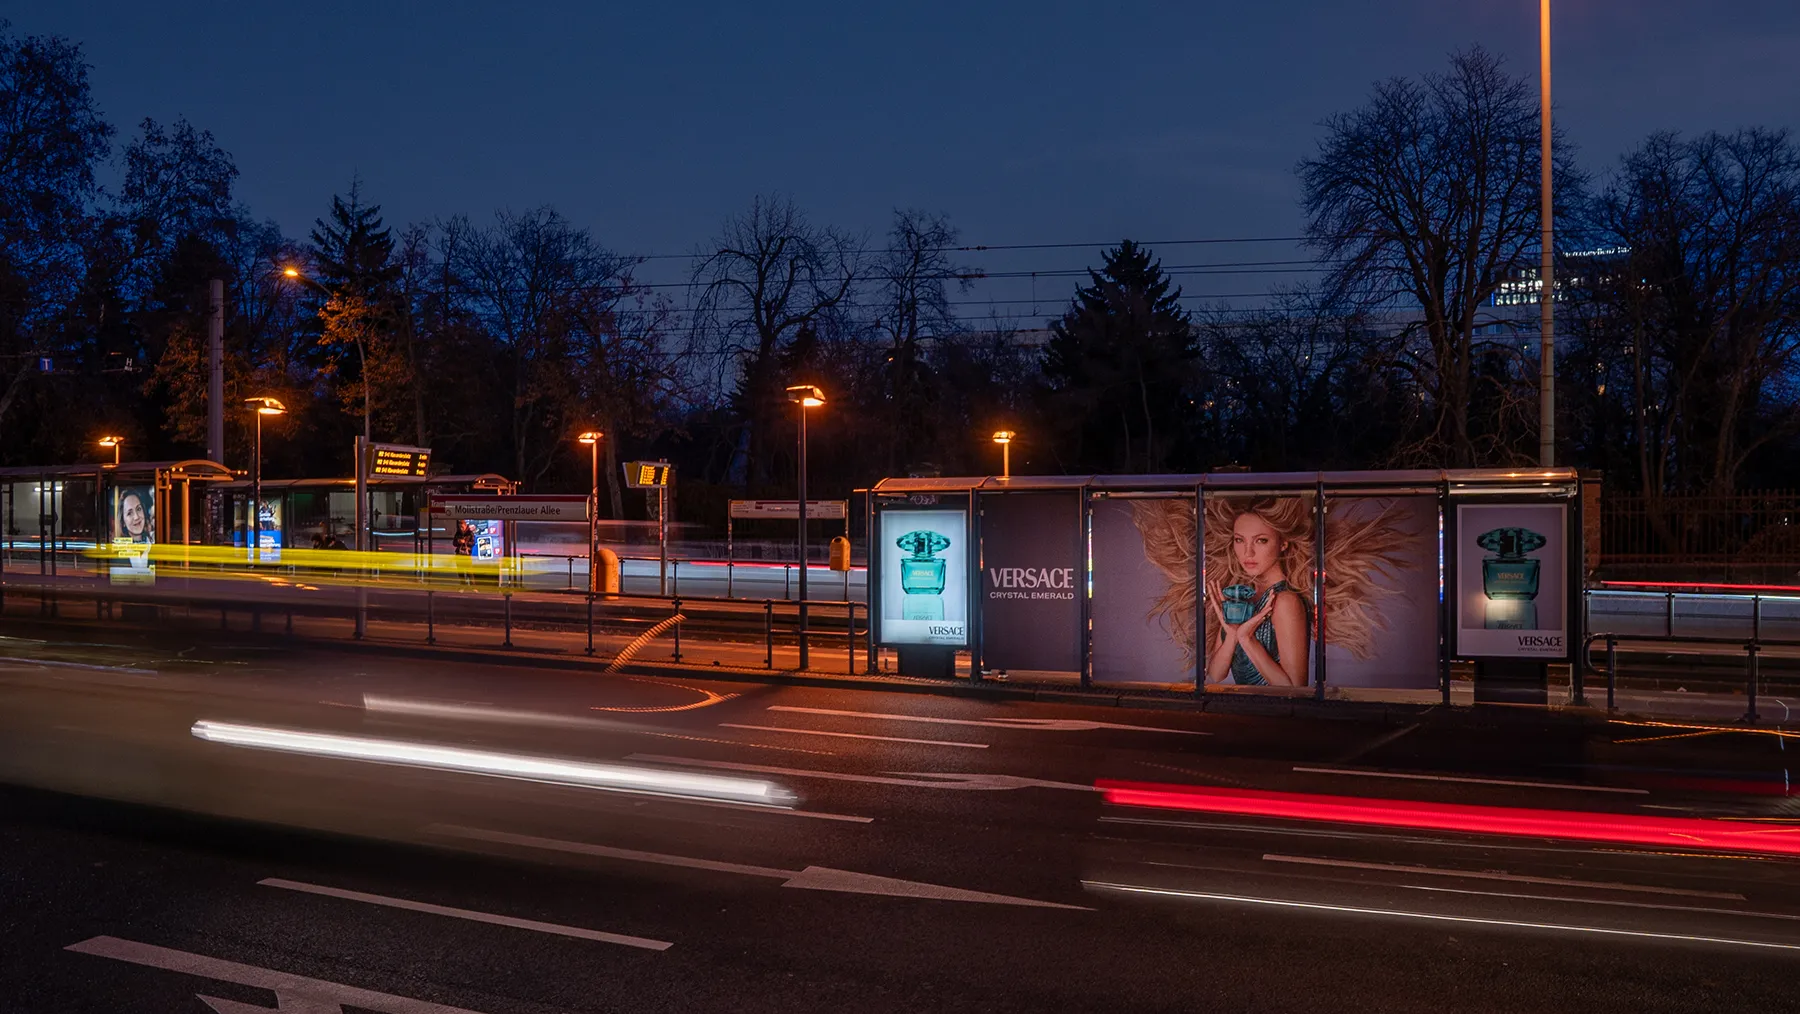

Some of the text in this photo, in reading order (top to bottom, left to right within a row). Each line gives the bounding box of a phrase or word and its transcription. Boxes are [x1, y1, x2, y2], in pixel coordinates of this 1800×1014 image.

[540, 505, 560, 515] Allee
[990, 567, 1074, 588] VERSACE
[990, 591, 1074, 600] CRYSTAL EMERALD
[929, 626, 964, 636] VERSACE
[1518, 636, 1562, 647] VERSACE
